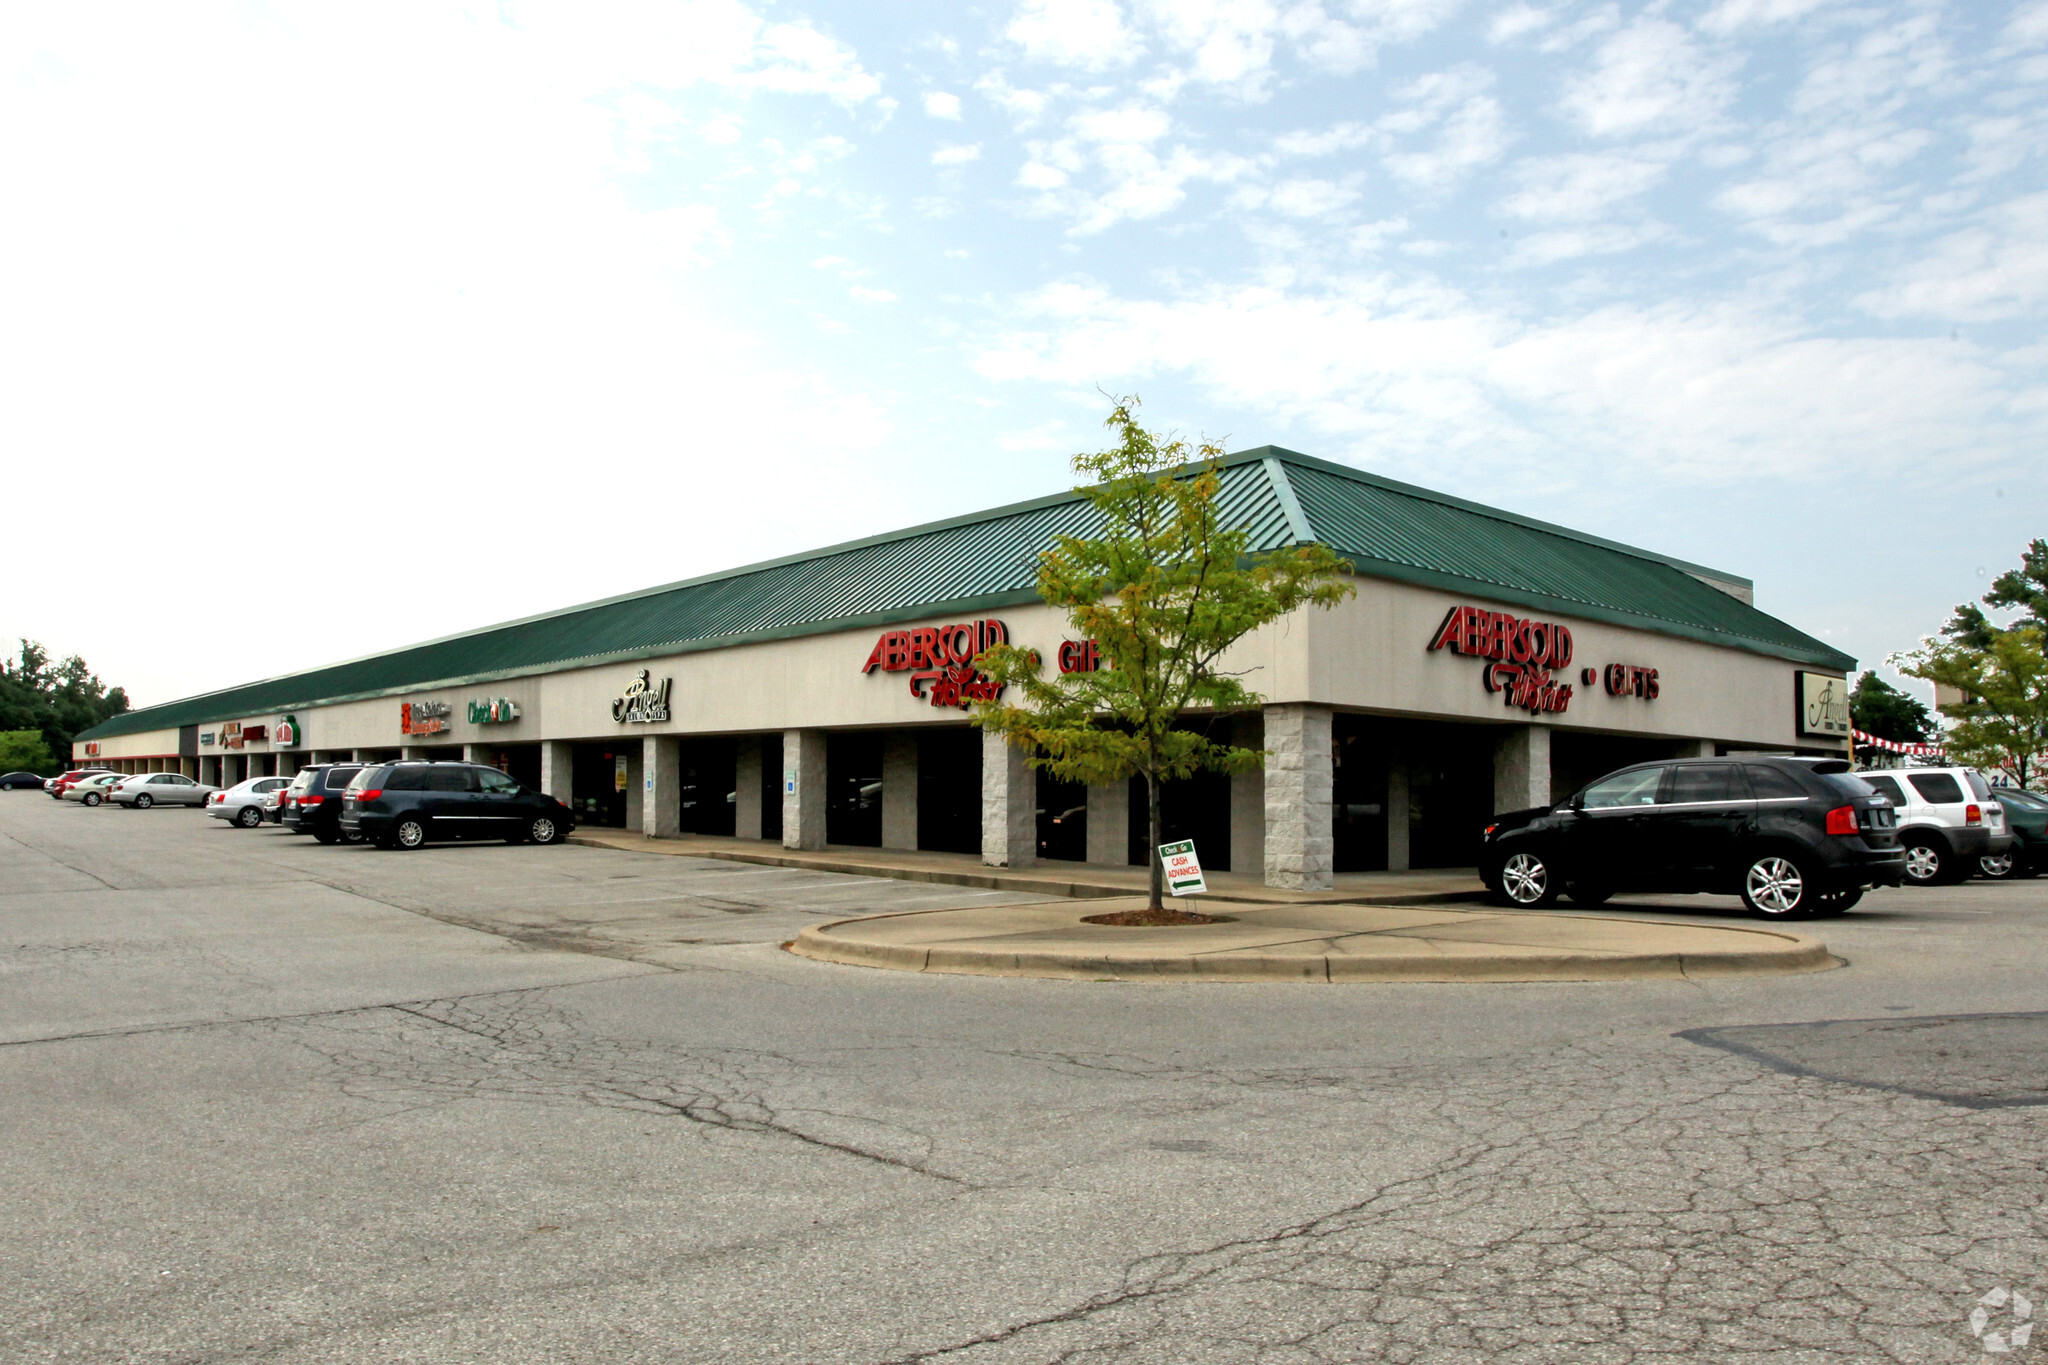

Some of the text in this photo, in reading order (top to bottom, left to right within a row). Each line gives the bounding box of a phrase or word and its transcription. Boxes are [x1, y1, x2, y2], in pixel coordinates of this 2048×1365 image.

[862, 619, 1006, 672] AEBERSOLD
[1430, 606, 1573, 668] AEBERSOLD
[910, 670, 1003, 708] Florist
[1487, 663, 1573, 713] Florist
[1606, 663, 1660, 699] GIFTS
[1991, 775, 2008, 788] 24
[1168, 865, 1199, 878] ADVANCES
[1171, 856, 1189, 866] CASH
